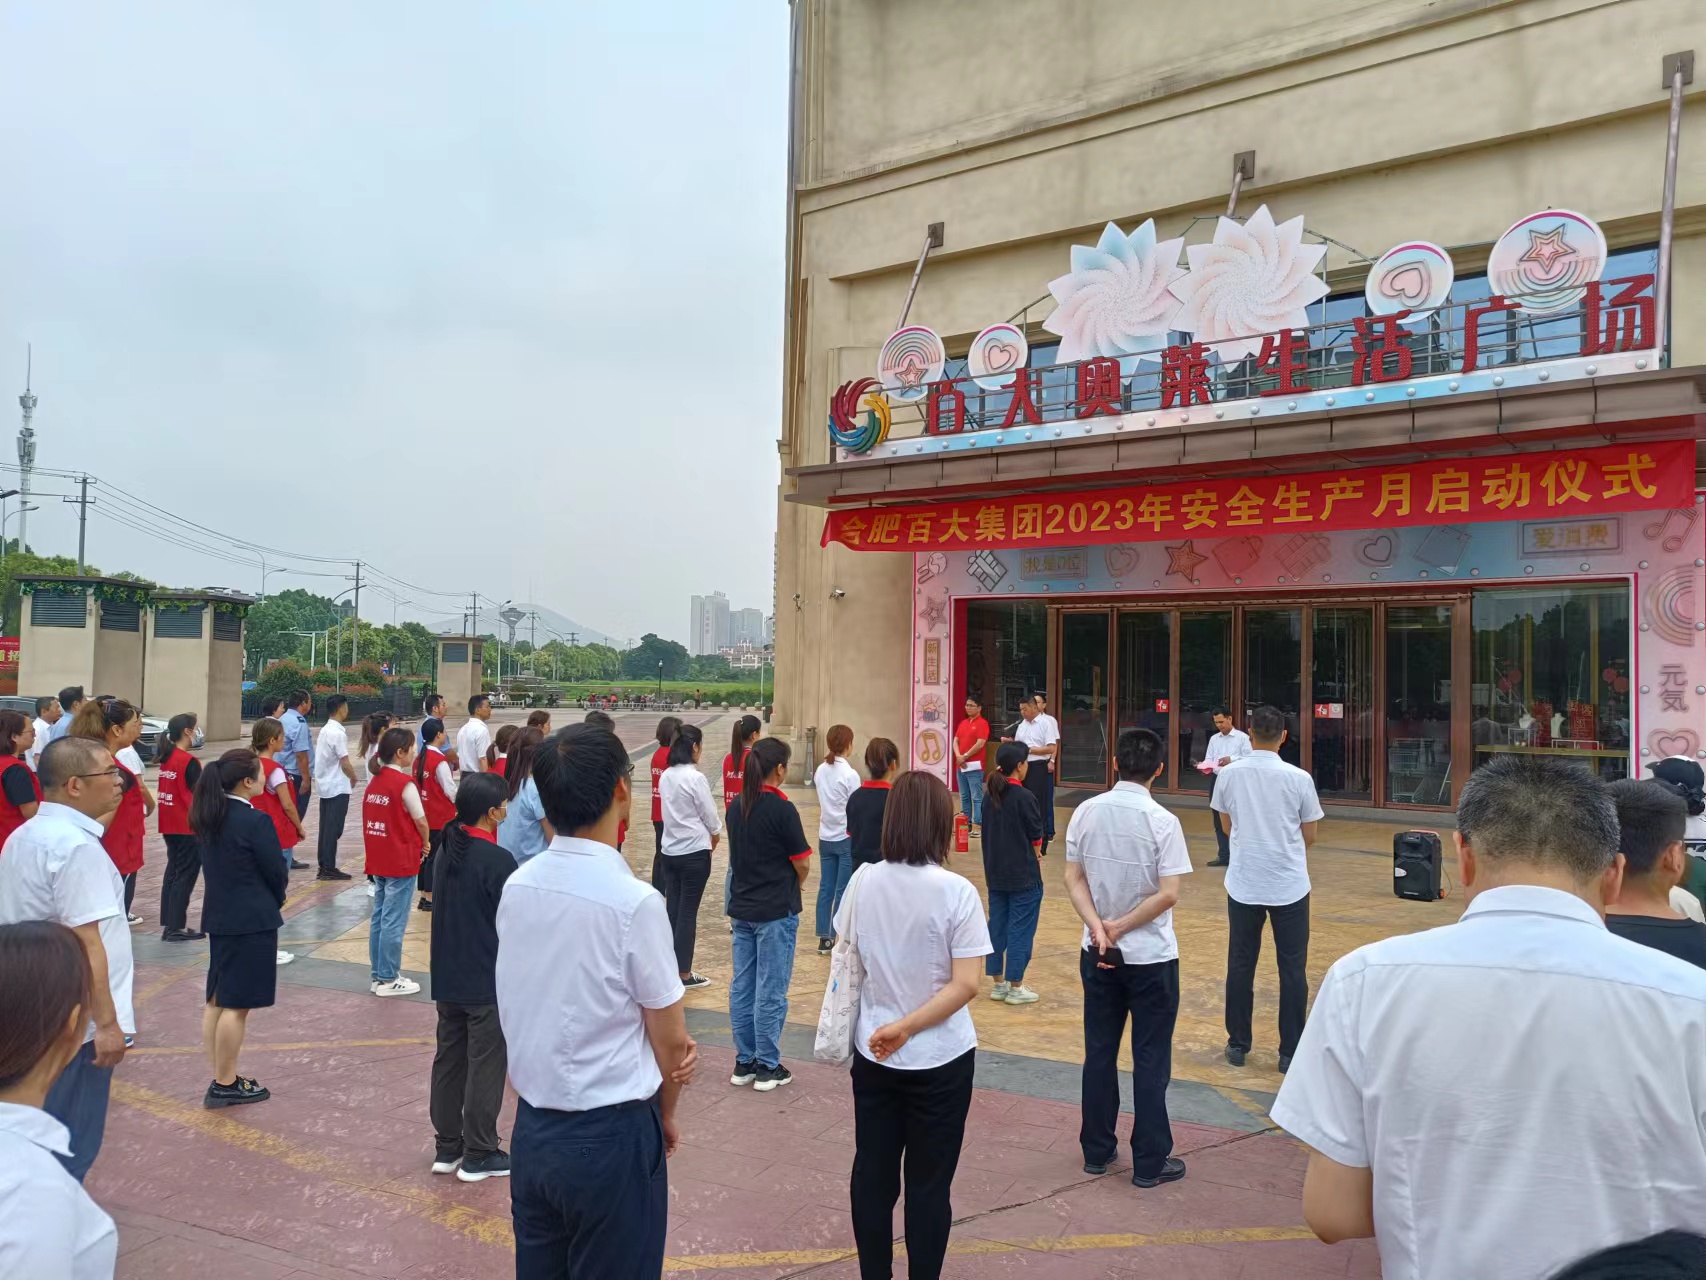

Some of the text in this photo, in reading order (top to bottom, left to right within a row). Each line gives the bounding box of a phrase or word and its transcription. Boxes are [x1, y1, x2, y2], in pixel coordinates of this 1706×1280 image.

[928, 273, 1656, 436] 百大奥莱生活广场
[840, 453, 1657, 545] 合肥百大集团2023年安全生产月启动仪式
